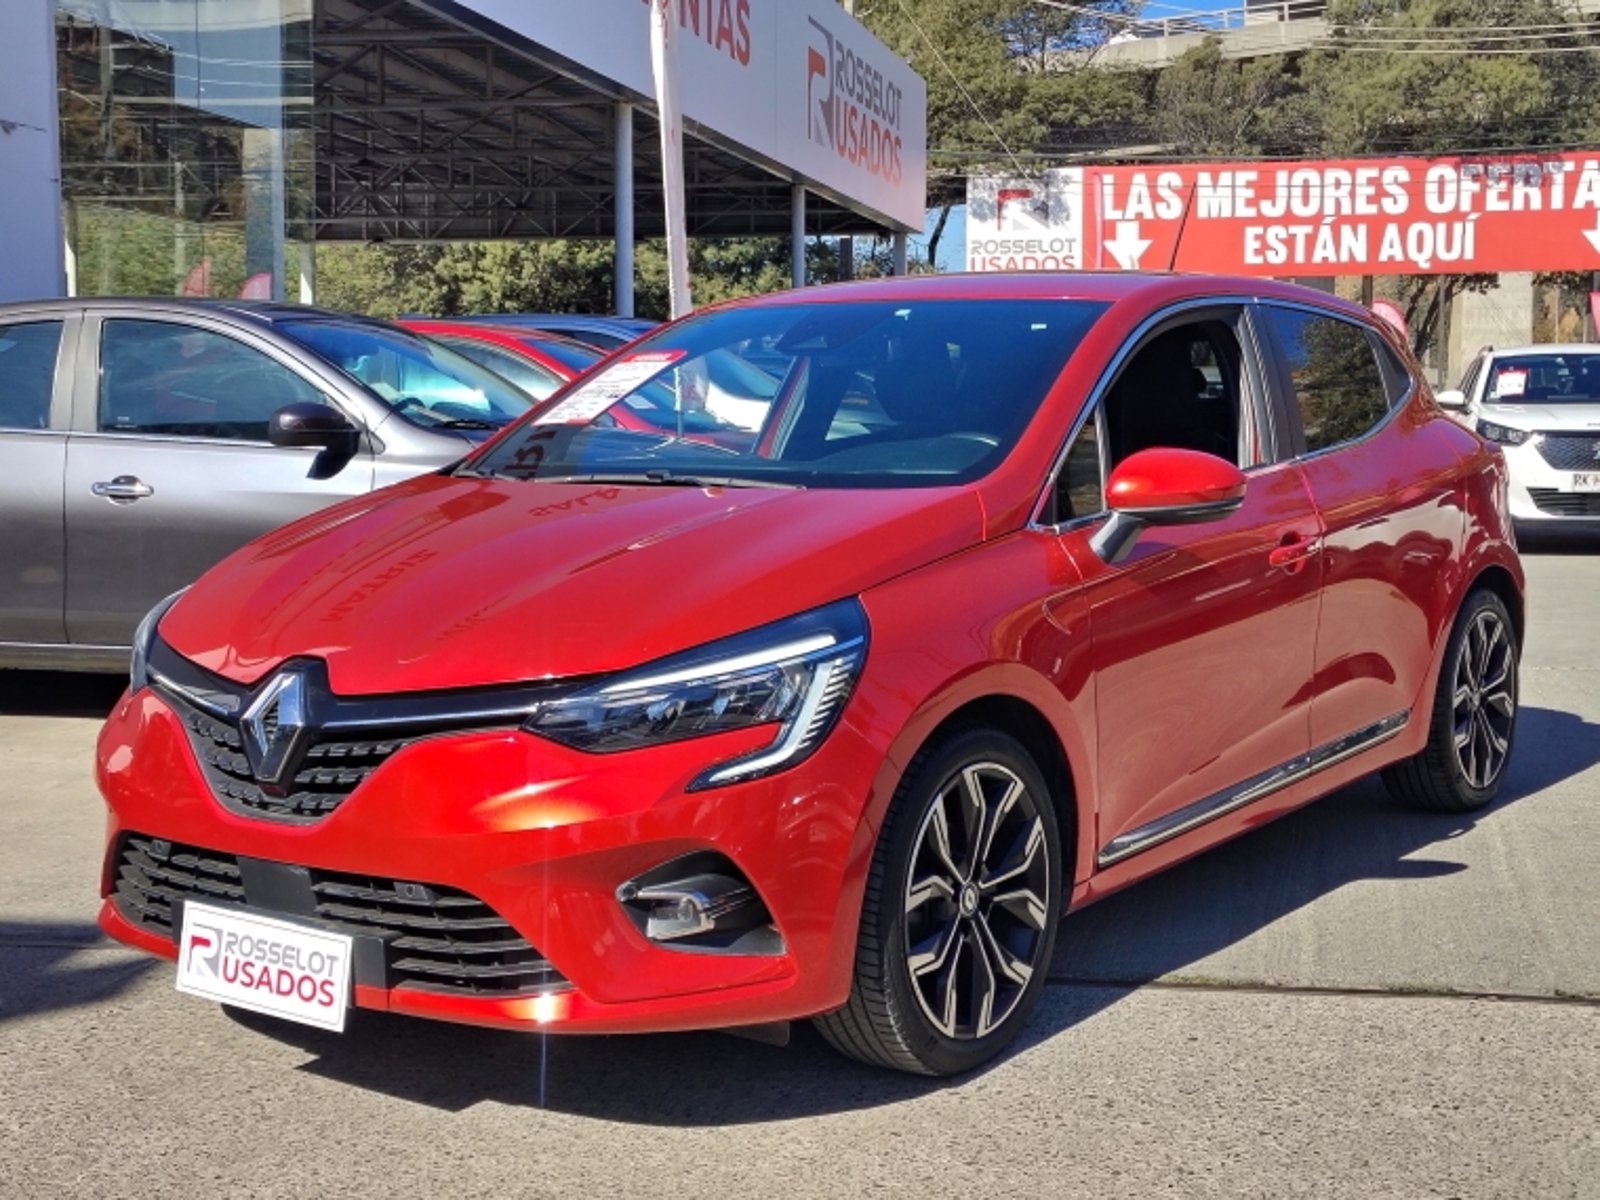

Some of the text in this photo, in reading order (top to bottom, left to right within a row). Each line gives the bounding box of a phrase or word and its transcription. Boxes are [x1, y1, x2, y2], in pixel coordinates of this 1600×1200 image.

[835, 39, 902, 131] ROSSELOT
[834, 97, 902, 187] USADOS
[1102, 171, 1183, 220] LAS
[1198, 166, 1410, 218] MEJORES
[970, 237, 1077, 255] ROSSELOT
[971, 256, 1076, 271] USADOS
[1243, 212, 1482, 268] ESTÁN AQUÍ
[222, 955, 336, 1007] USADOS
[224, 932, 339, 977] ROSSELOT
